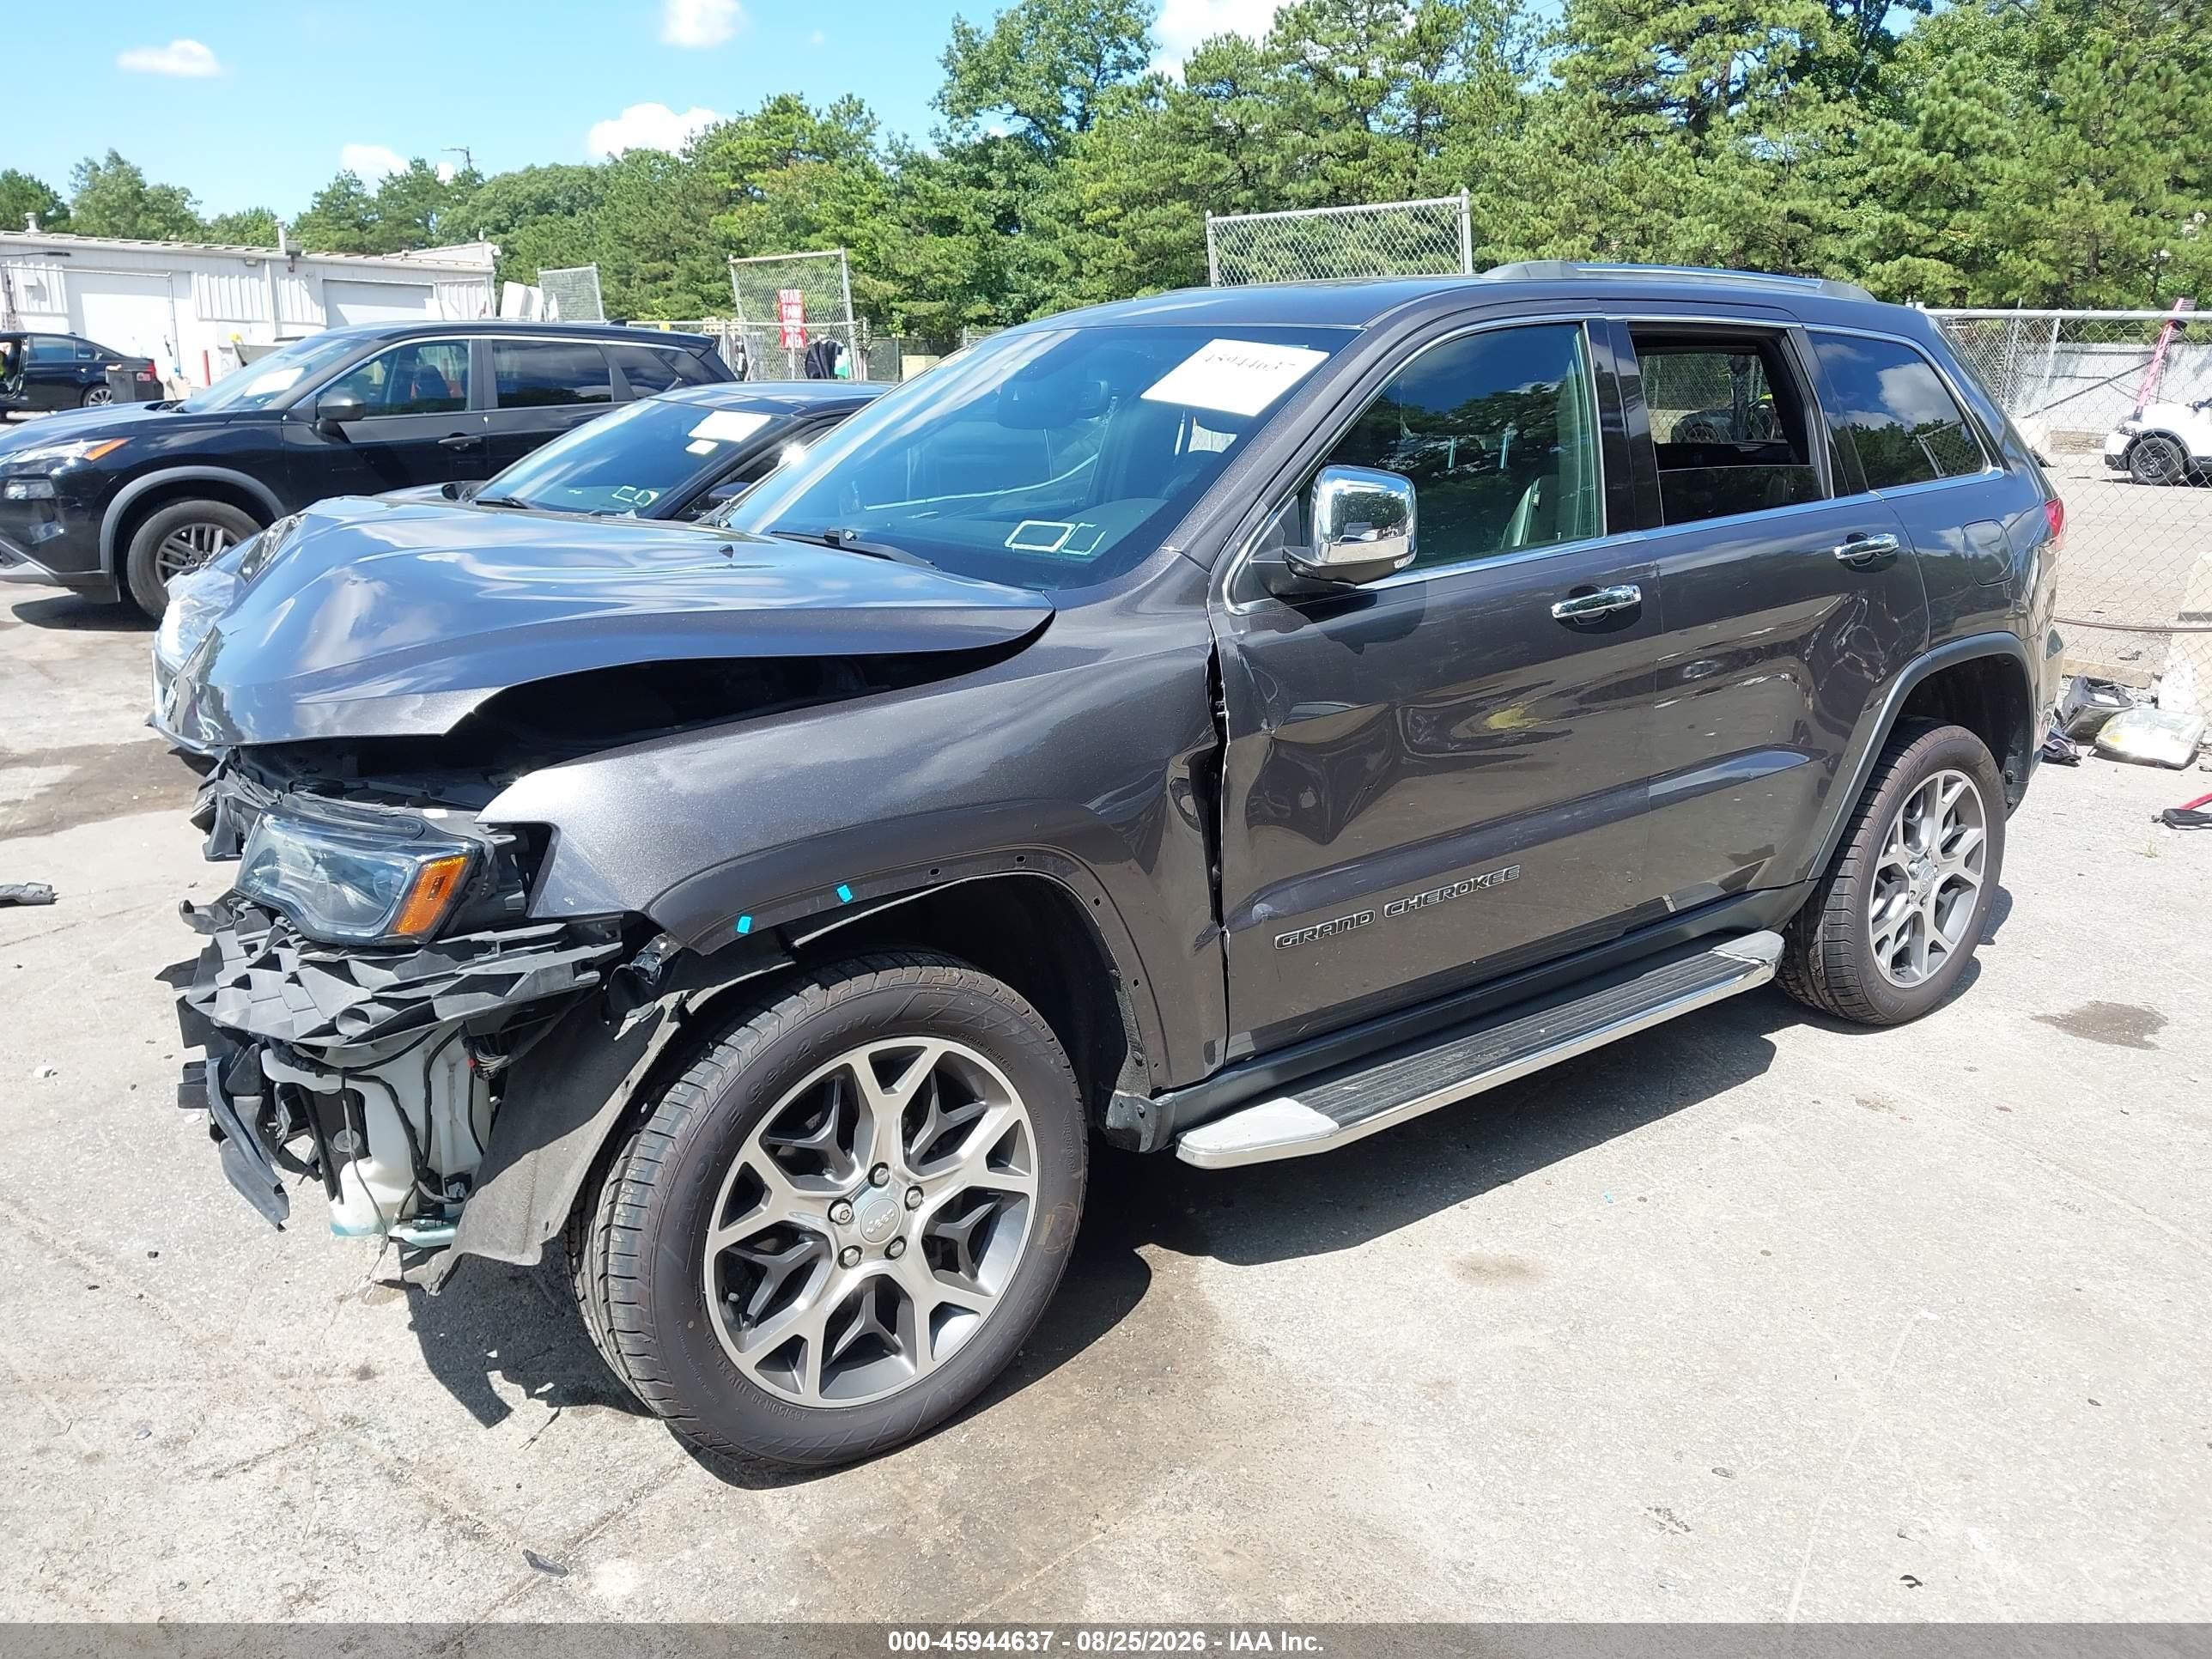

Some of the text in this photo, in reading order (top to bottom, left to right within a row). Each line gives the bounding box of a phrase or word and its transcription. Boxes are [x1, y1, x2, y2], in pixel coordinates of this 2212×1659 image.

[1273, 865, 1521, 951] GRAND CHEROKEE
[866, 1209, 895, 1234] Jeep
